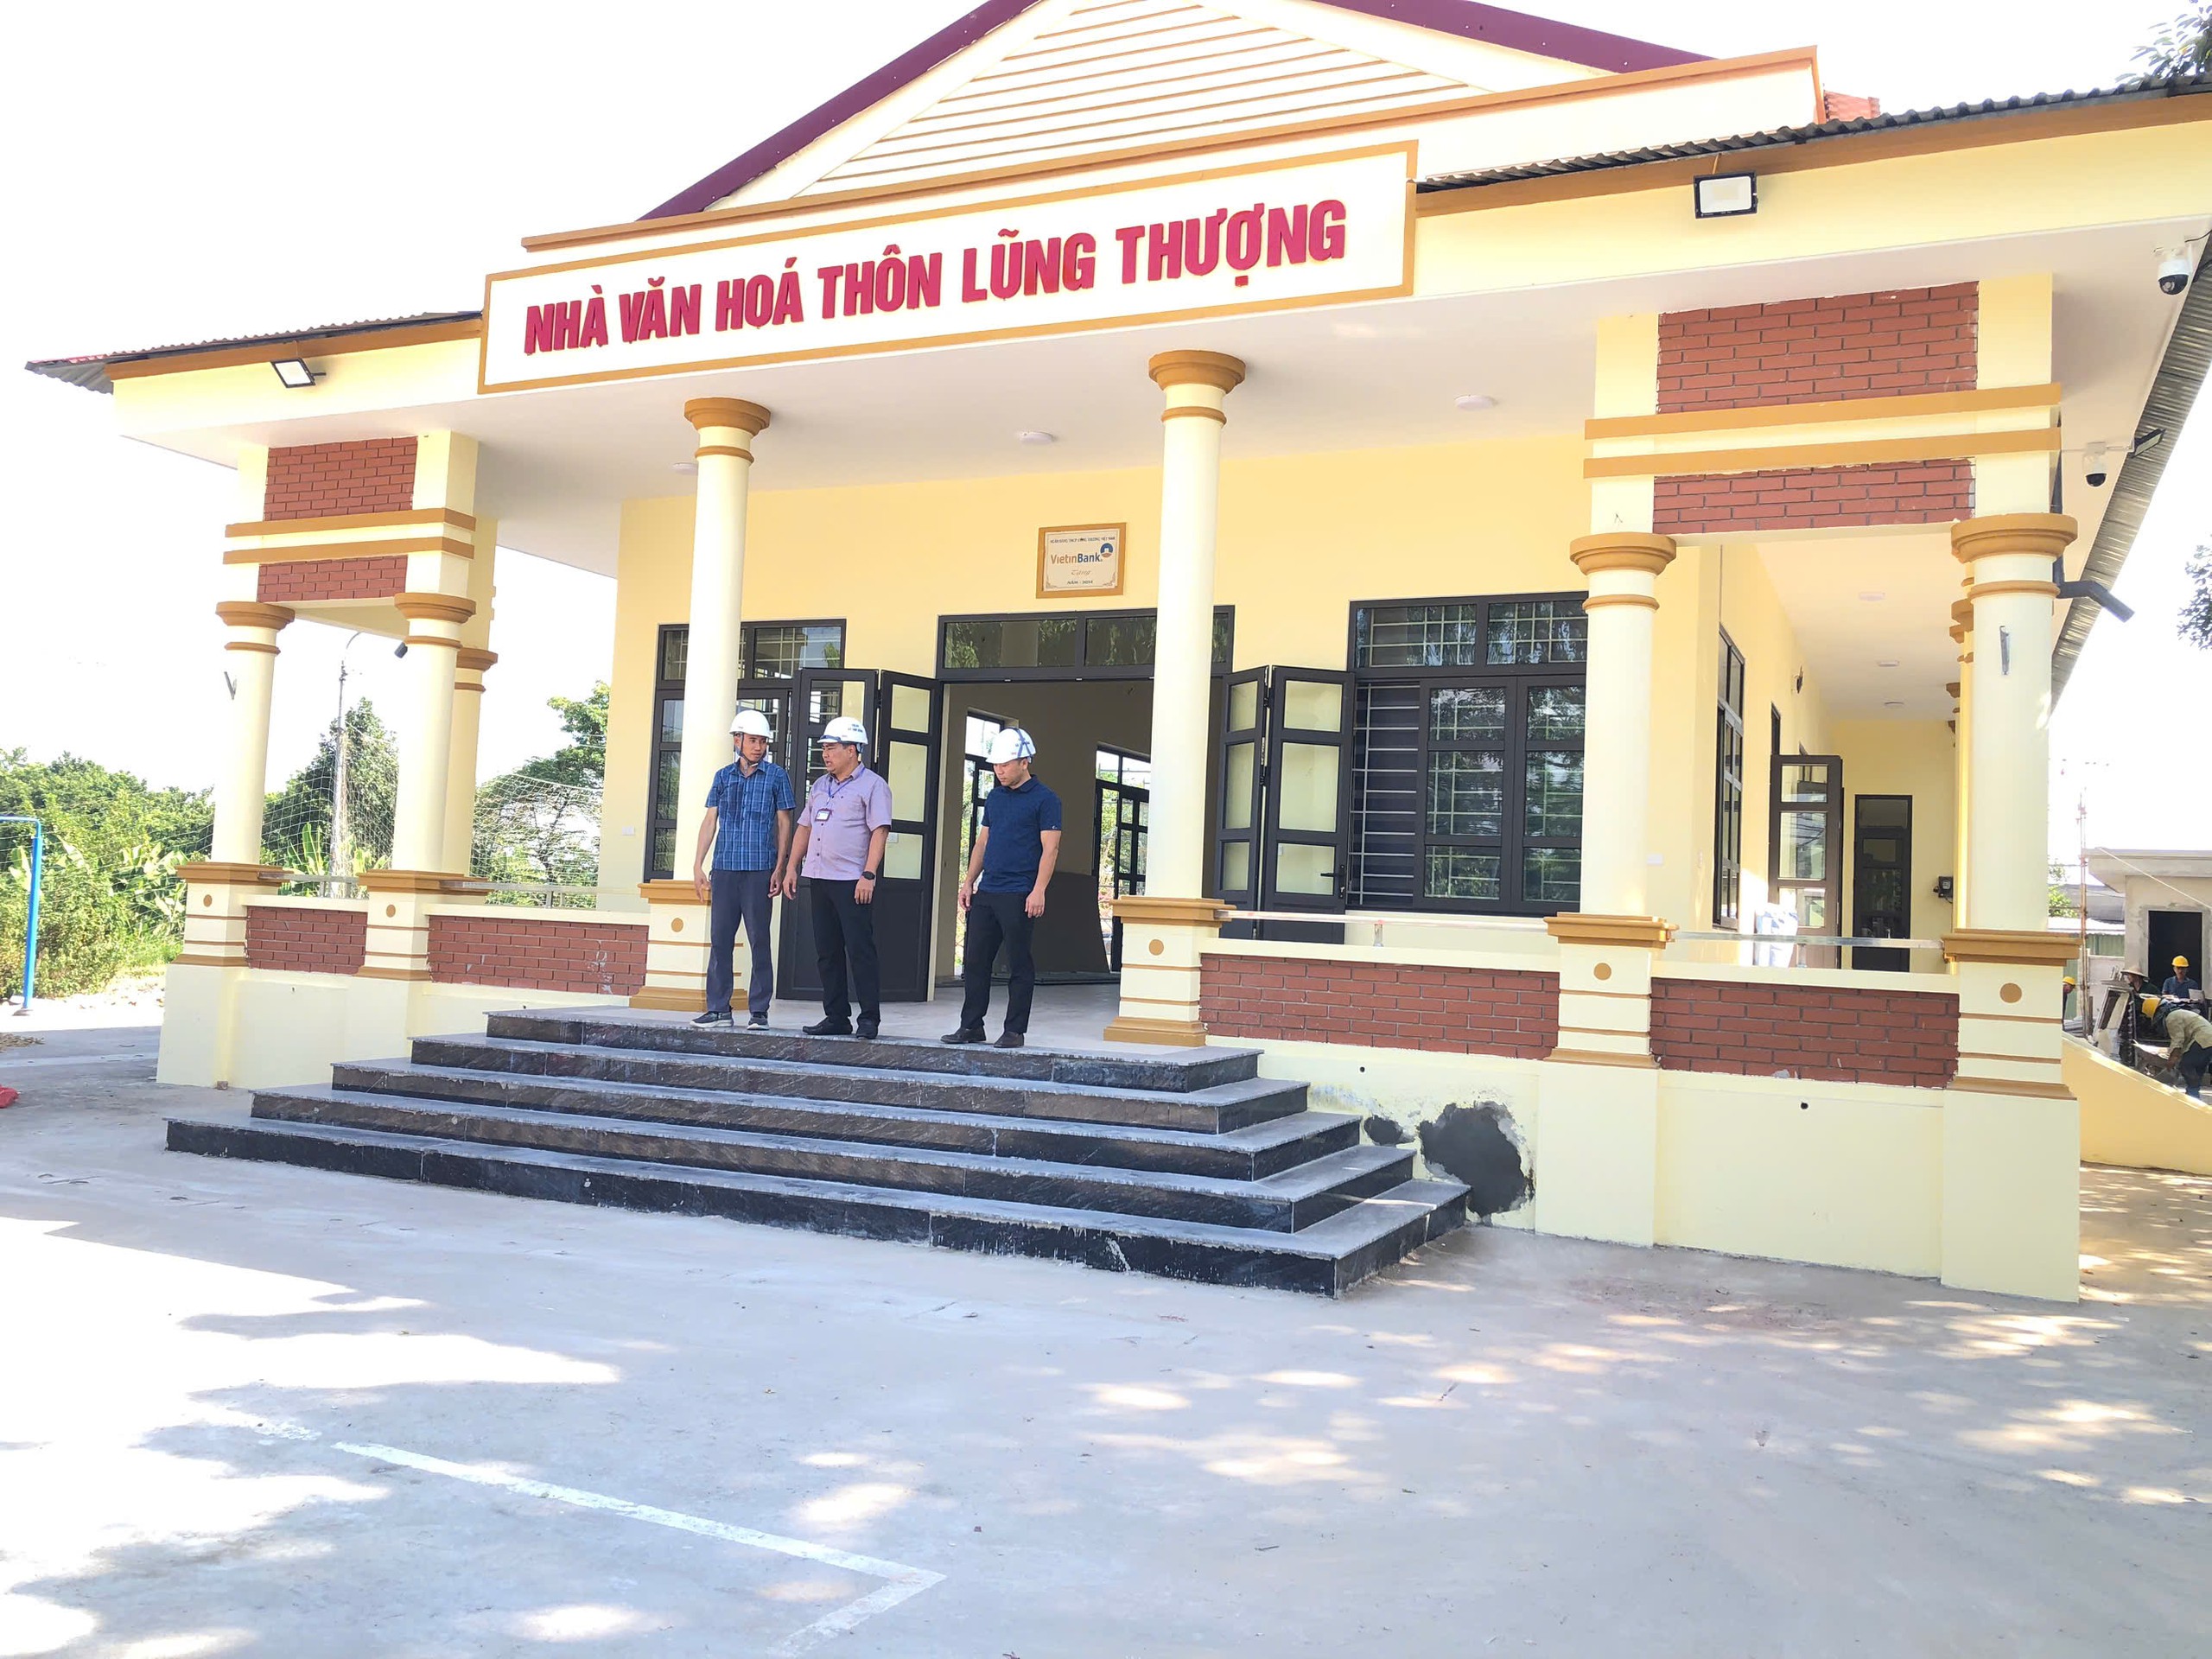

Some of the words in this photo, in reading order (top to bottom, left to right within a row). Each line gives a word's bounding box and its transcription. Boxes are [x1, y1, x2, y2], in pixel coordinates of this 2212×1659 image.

[524, 284, 609, 356] NHÀ
[619, 276, 702, 345] VĂN
[715, 257, 804, 333] HOÁ
[817, 244, 944, 321] THÔN
[962, 228, 1097, 304] LŨNG
[1116, 199, 1347, 286] THƯỢNG
[1051, 552, 1101, 564] VietinBank
